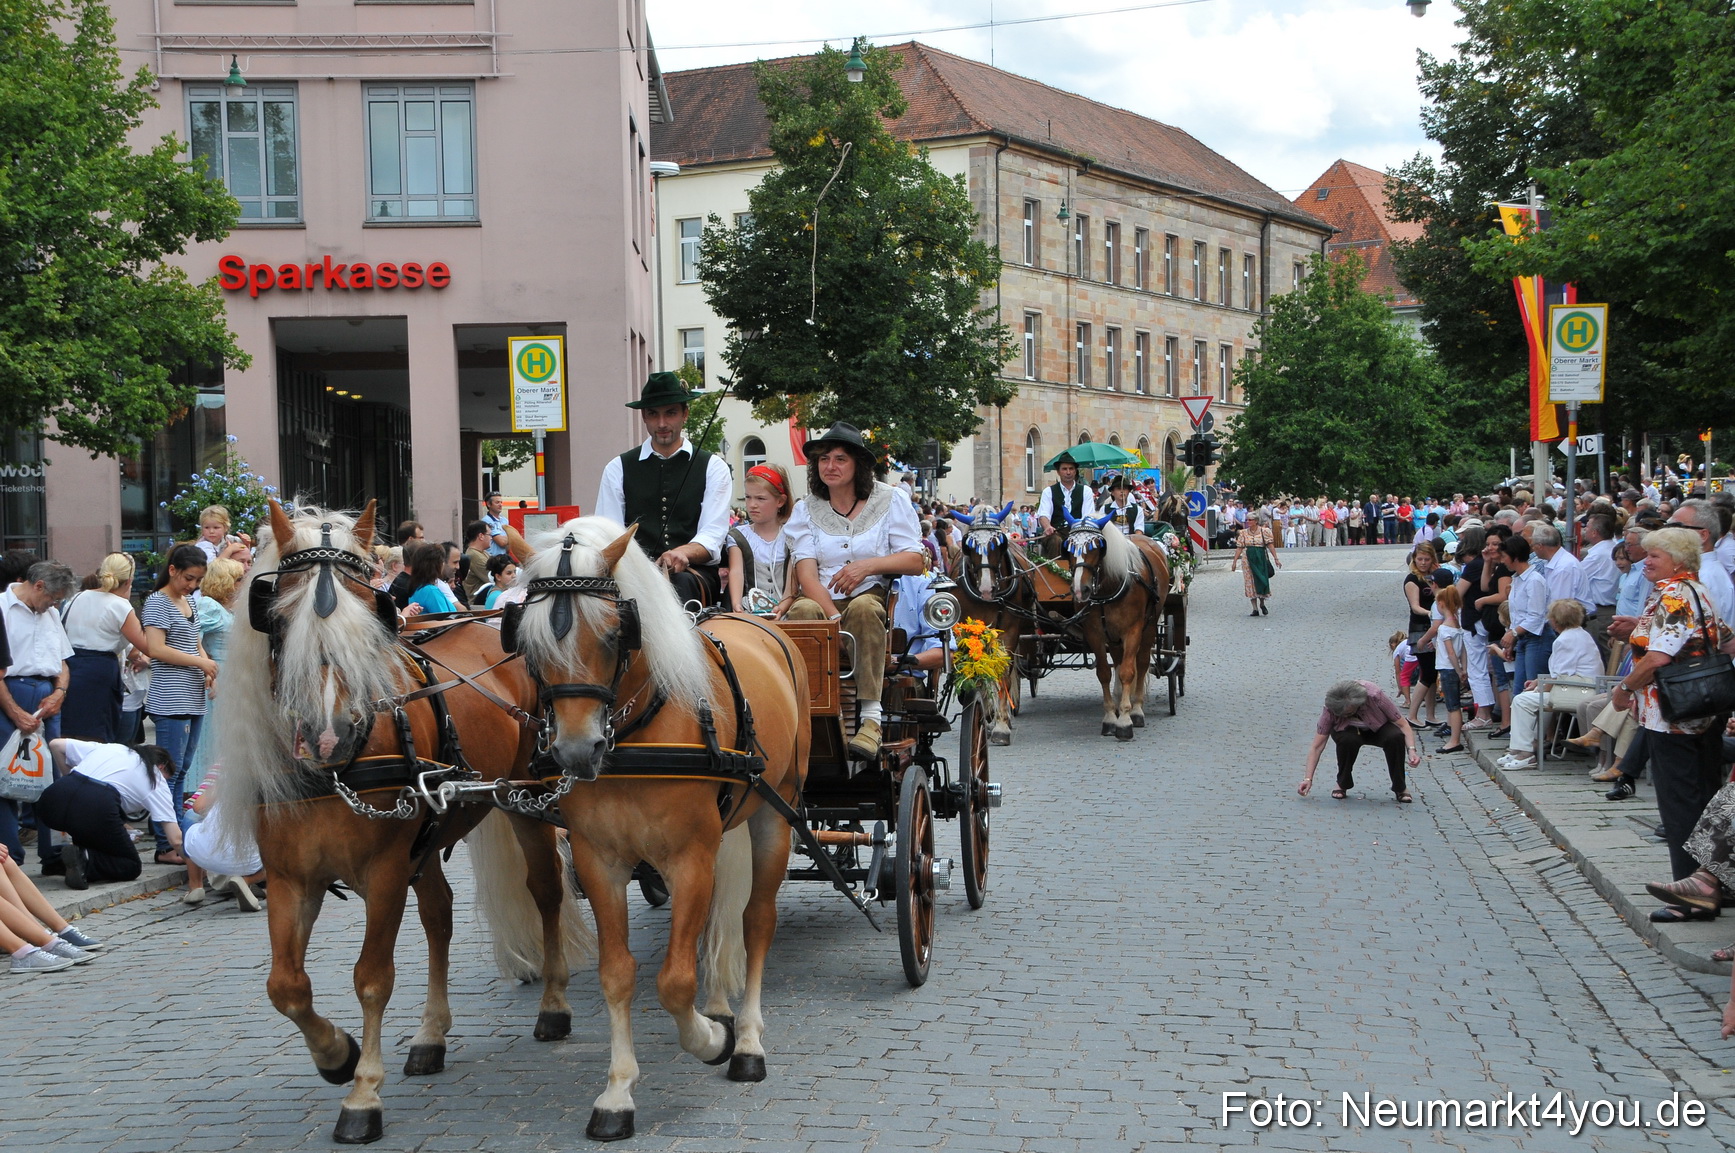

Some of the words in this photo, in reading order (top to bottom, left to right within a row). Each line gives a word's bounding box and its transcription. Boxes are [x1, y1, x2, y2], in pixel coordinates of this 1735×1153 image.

[218, 254, 450, 298] Sparkasse
[1567, 321, 1588, 343] H
[527, 352, 546, 374] H
